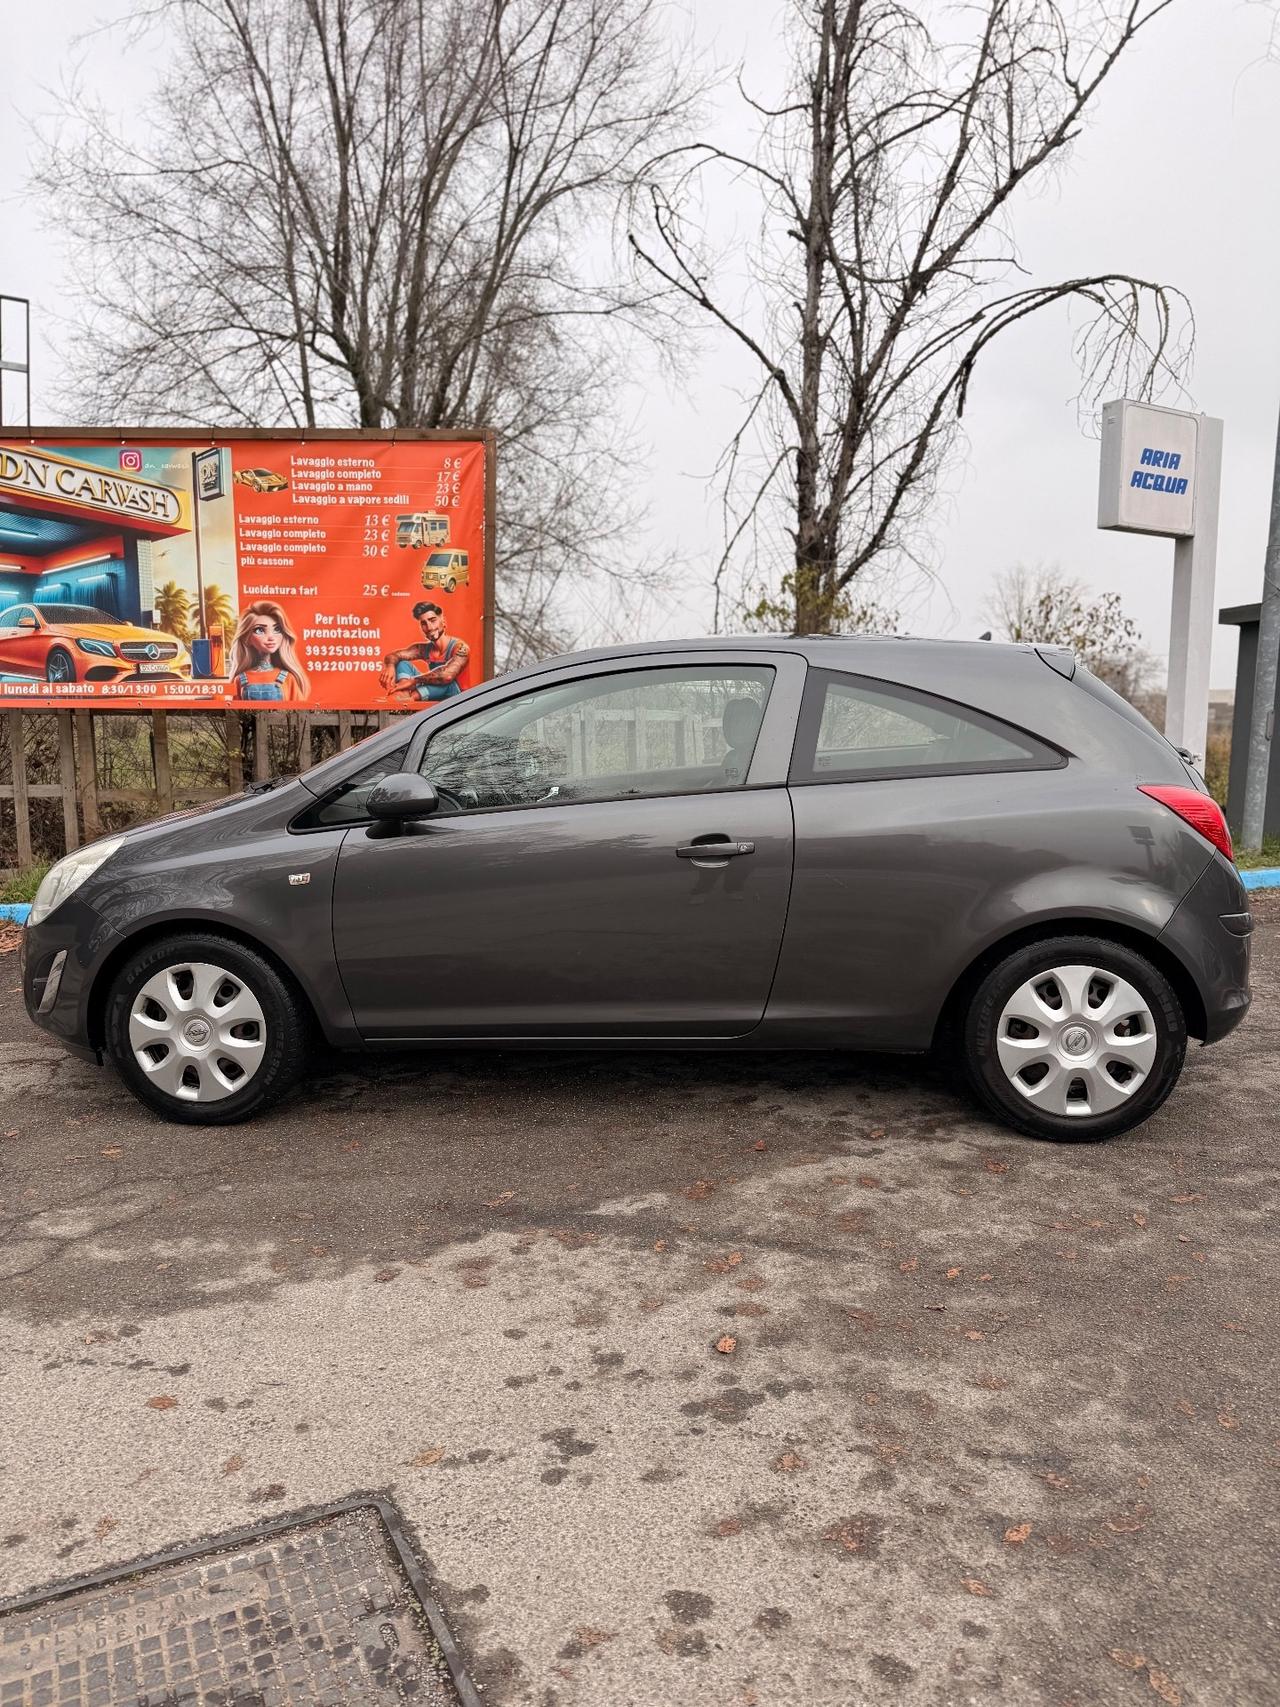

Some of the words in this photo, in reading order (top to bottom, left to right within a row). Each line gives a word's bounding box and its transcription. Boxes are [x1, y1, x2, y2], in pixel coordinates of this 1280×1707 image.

[291, 455, 335, 467] Lavaggio
[337, 457, 375, 467] esterno
[444, 457, 451, 469] 8
[453, 457, 462, 469] €
[1140, 447, 1181, 470] ARIA
[291, 468, 335, 480] Lavaggio
[337, 469, 381, 480] completo
[436, 471, 451, 482] 17
[452, 470, 460, 481] €
[0, 453, 49, 488] DN
[56, 469, 169, 518] CARWASH
[292, 480, 335, 492] Lavaggio
[345, 483, 373, 491] mano
[436, 483, 449, 494] 23
[452, 482, 461, 494] €
[1130, 470, 1188, 495] ACQUA
[292, 493, 337, 505] Lavaggio
[348, 496, 381, 506] vapore
[383, 494, 409, 504] sedili
[434, 495, 449, 507] 50
[451, 495, 460, 507] €
[239, 514, 281, 525] Lavaggio
[283, 516, 319, 524] esterno
[365, 514, 378, 526] 13
[382, 513, 391, 526] €
[240, 527, 281, 539] Lavaggio
[283, 529, 326, 540] completo
[364, 528, 378, 541] 23
[381, 529, 390, 542] €
[240, 541, 282, 553] Lavaggio
[283, 542, 326, 554] completo
[362, 544, 378, 557] 30
[380, 544, 389, 557] €
[241, 555, 255, 566] più
[257, 557, 294, 566] cassone
[243, 584, 297, 595] Lucidatura
[299, 585, 318, 595] fari
[363, 584, 378, 596] 25
[381, 584, 390, 597] €
[315, 612, 334, 625] Per
[336, 613, 360, 626] info
[363, 616, 370, 625] e
[303, 627, 380, 640] prenotazioni
[42, 683, 52, 694] al
[56, 683, 94, 694] sabato
